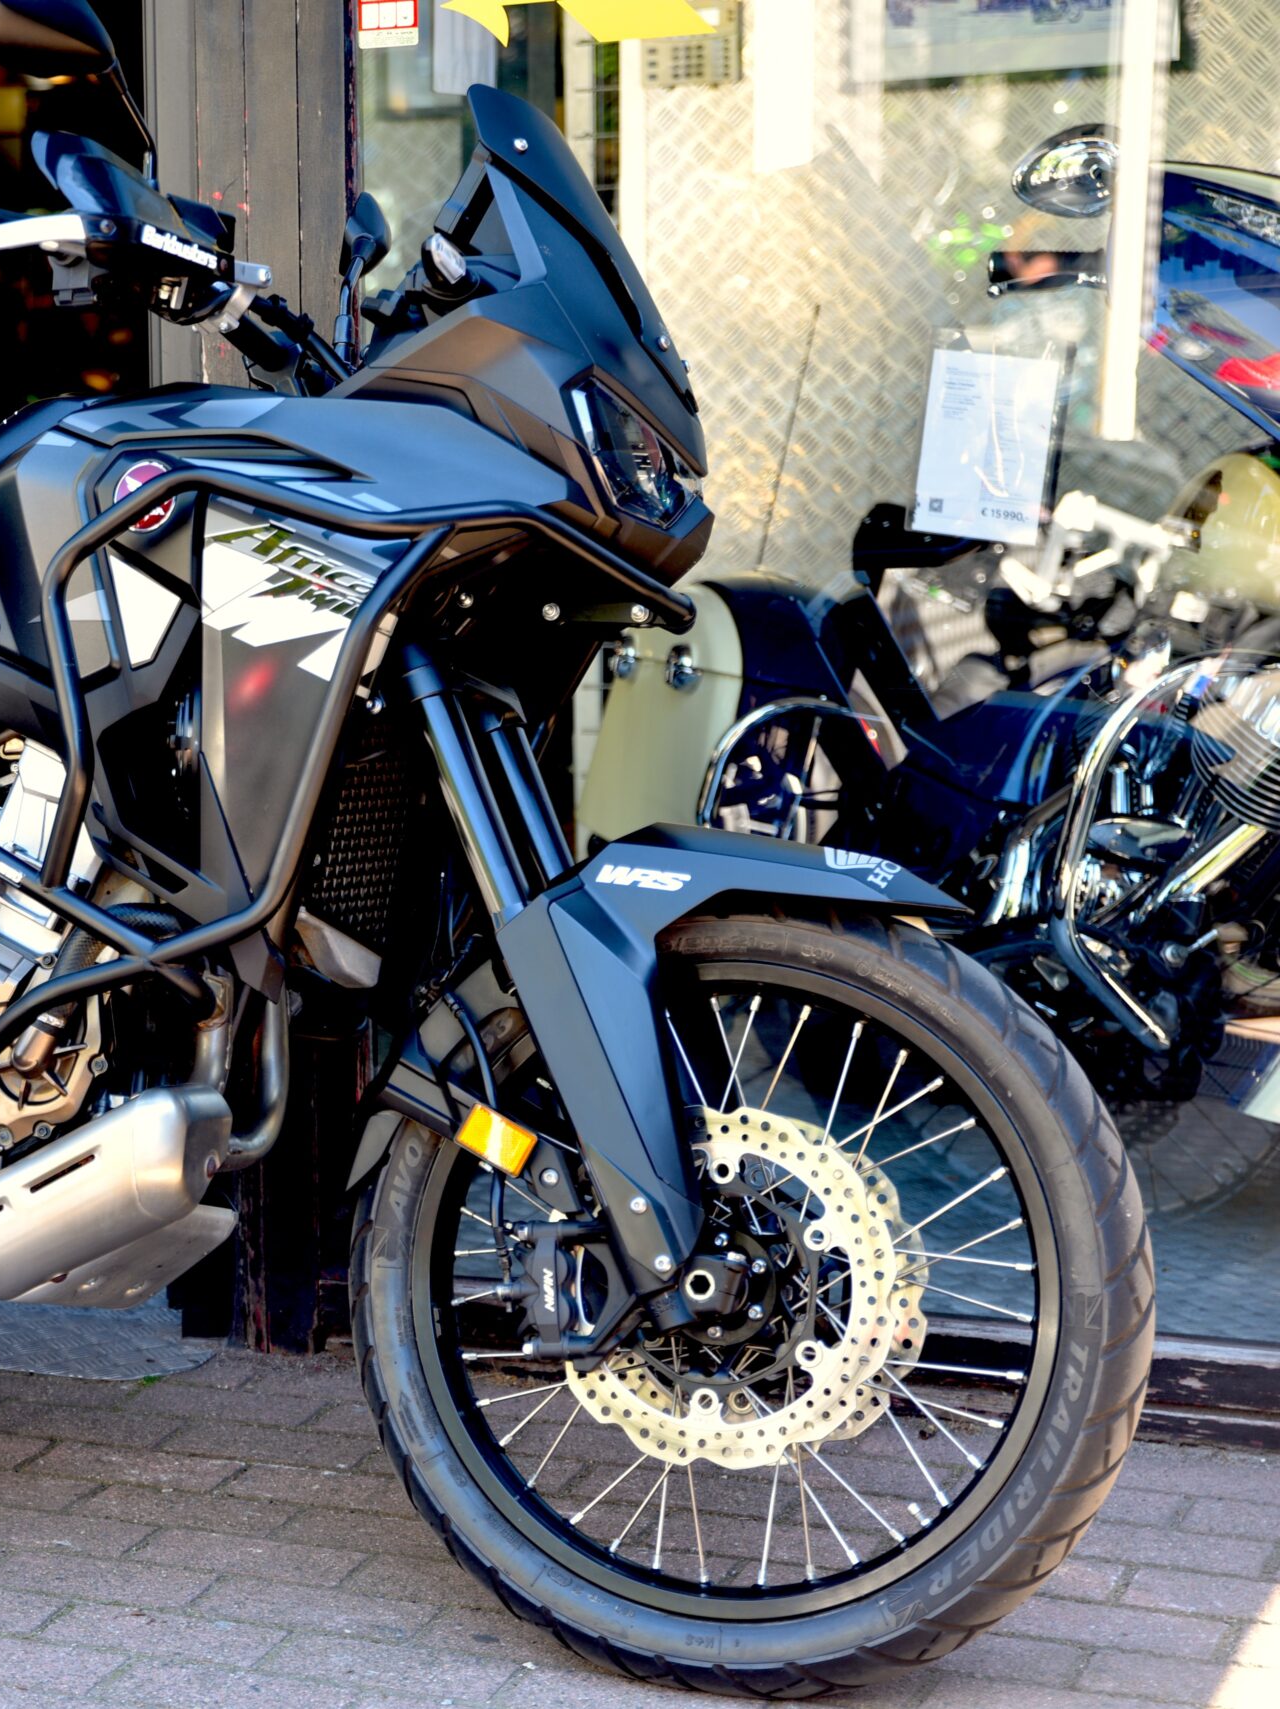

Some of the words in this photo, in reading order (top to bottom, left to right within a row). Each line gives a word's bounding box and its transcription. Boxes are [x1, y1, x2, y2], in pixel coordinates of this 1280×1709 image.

[214, 519, 376, 593] Africa
[595, 864, 692, 892] WRS
[927, 1341, 1090, 1597] TRAILRIDER
